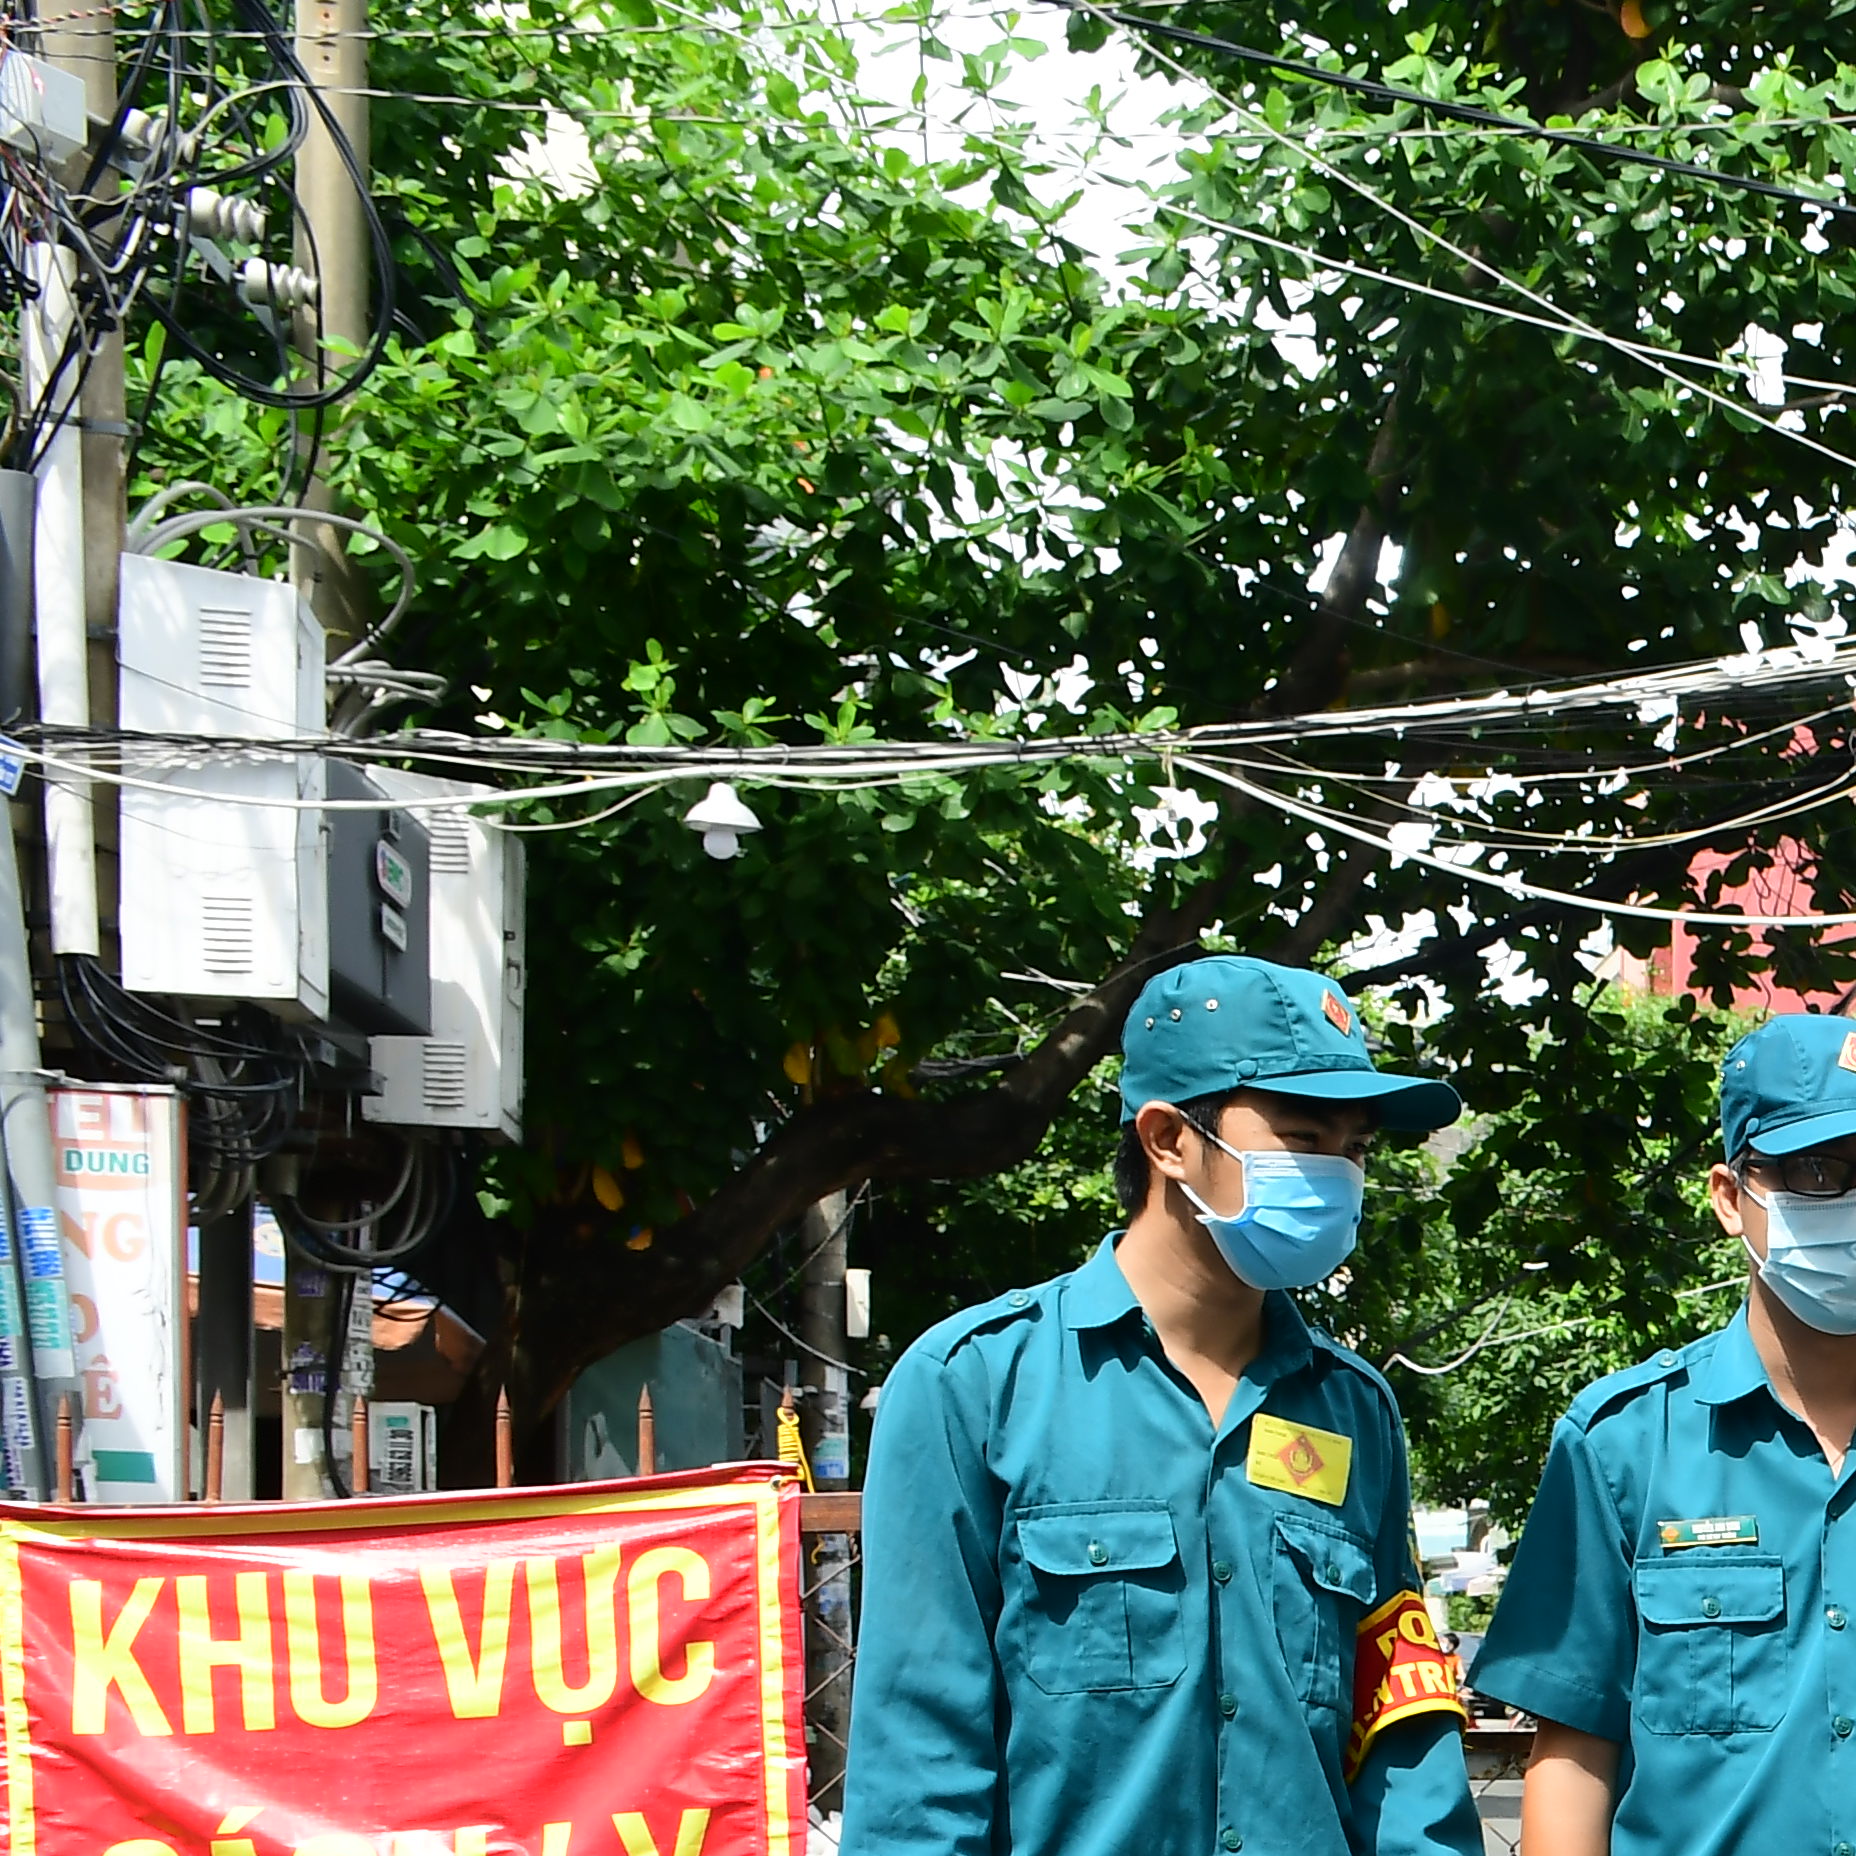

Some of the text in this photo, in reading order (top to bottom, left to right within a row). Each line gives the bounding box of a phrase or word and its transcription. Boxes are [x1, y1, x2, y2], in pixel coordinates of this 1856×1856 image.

[64, 1149, 151, 1176] DUNG
[69, 1544, 716, 1747] KHU VỰC
